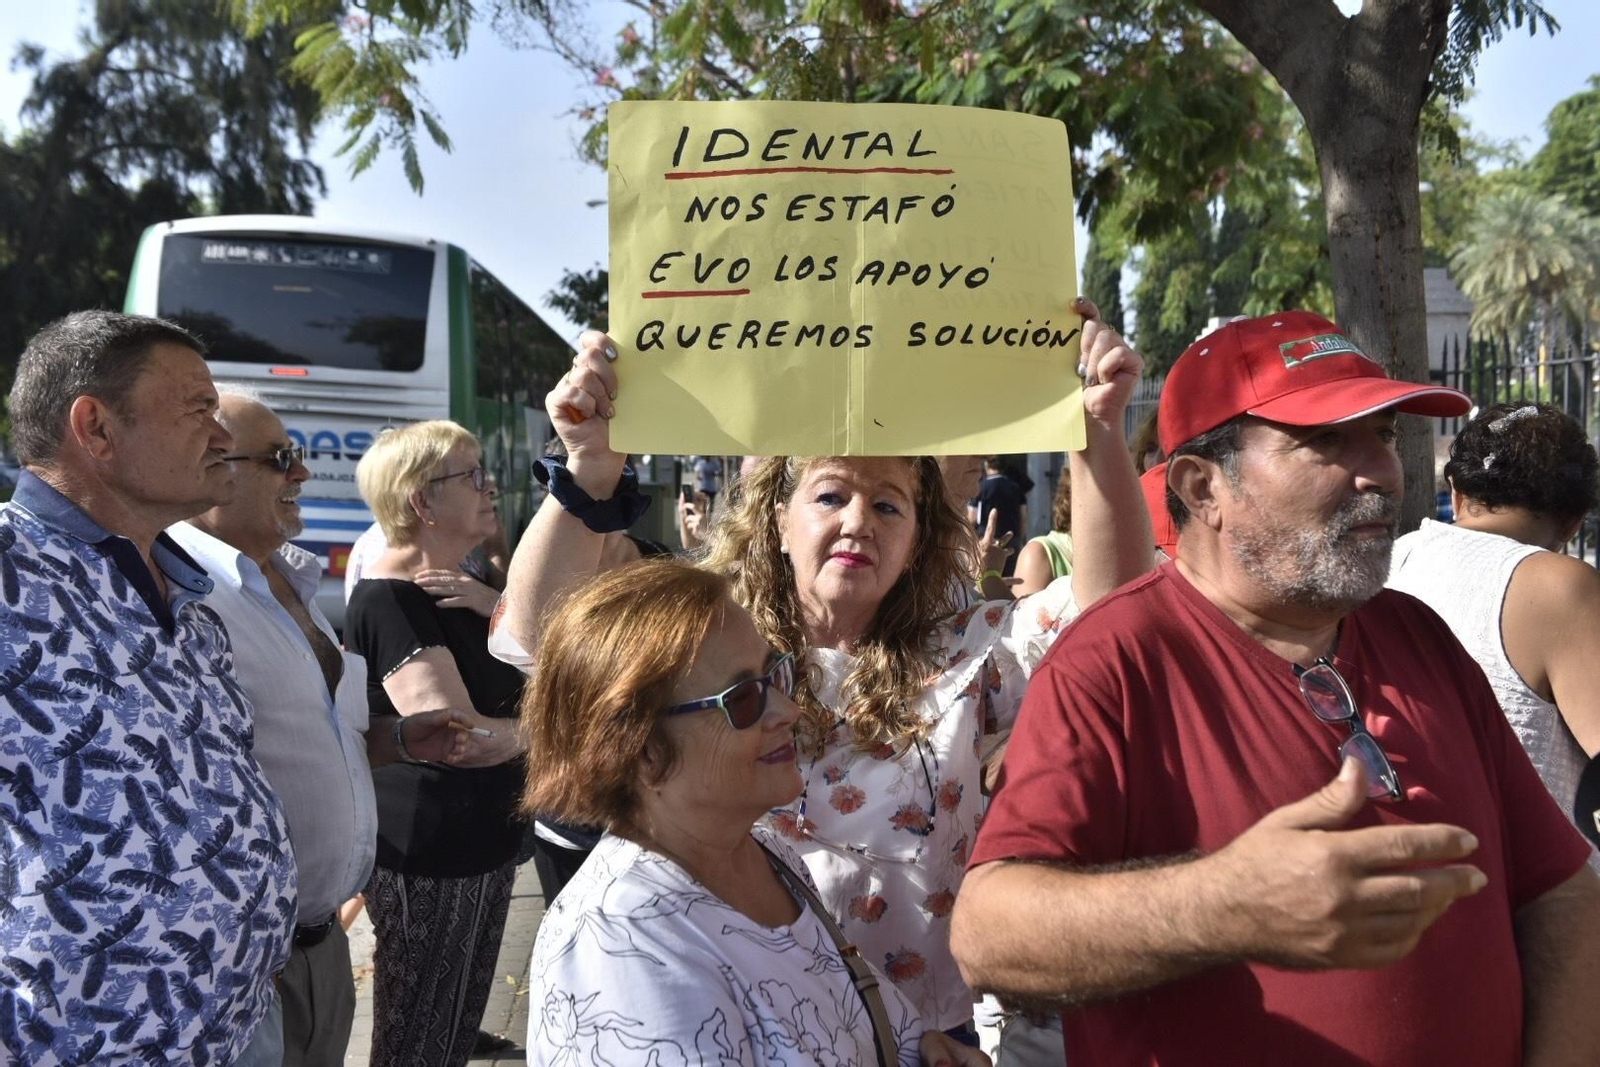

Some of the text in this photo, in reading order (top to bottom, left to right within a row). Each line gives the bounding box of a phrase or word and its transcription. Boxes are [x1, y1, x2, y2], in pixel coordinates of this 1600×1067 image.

[672, 126, 937, 168] IDENTAL
[684, 193, 768, 223] NOS
[785, 183, 957, 224] ESTAFÓ
[649, 251, 995, 289] EVO LOS APOYÓ
[635, 319, 873, 352] QUEREMOS
